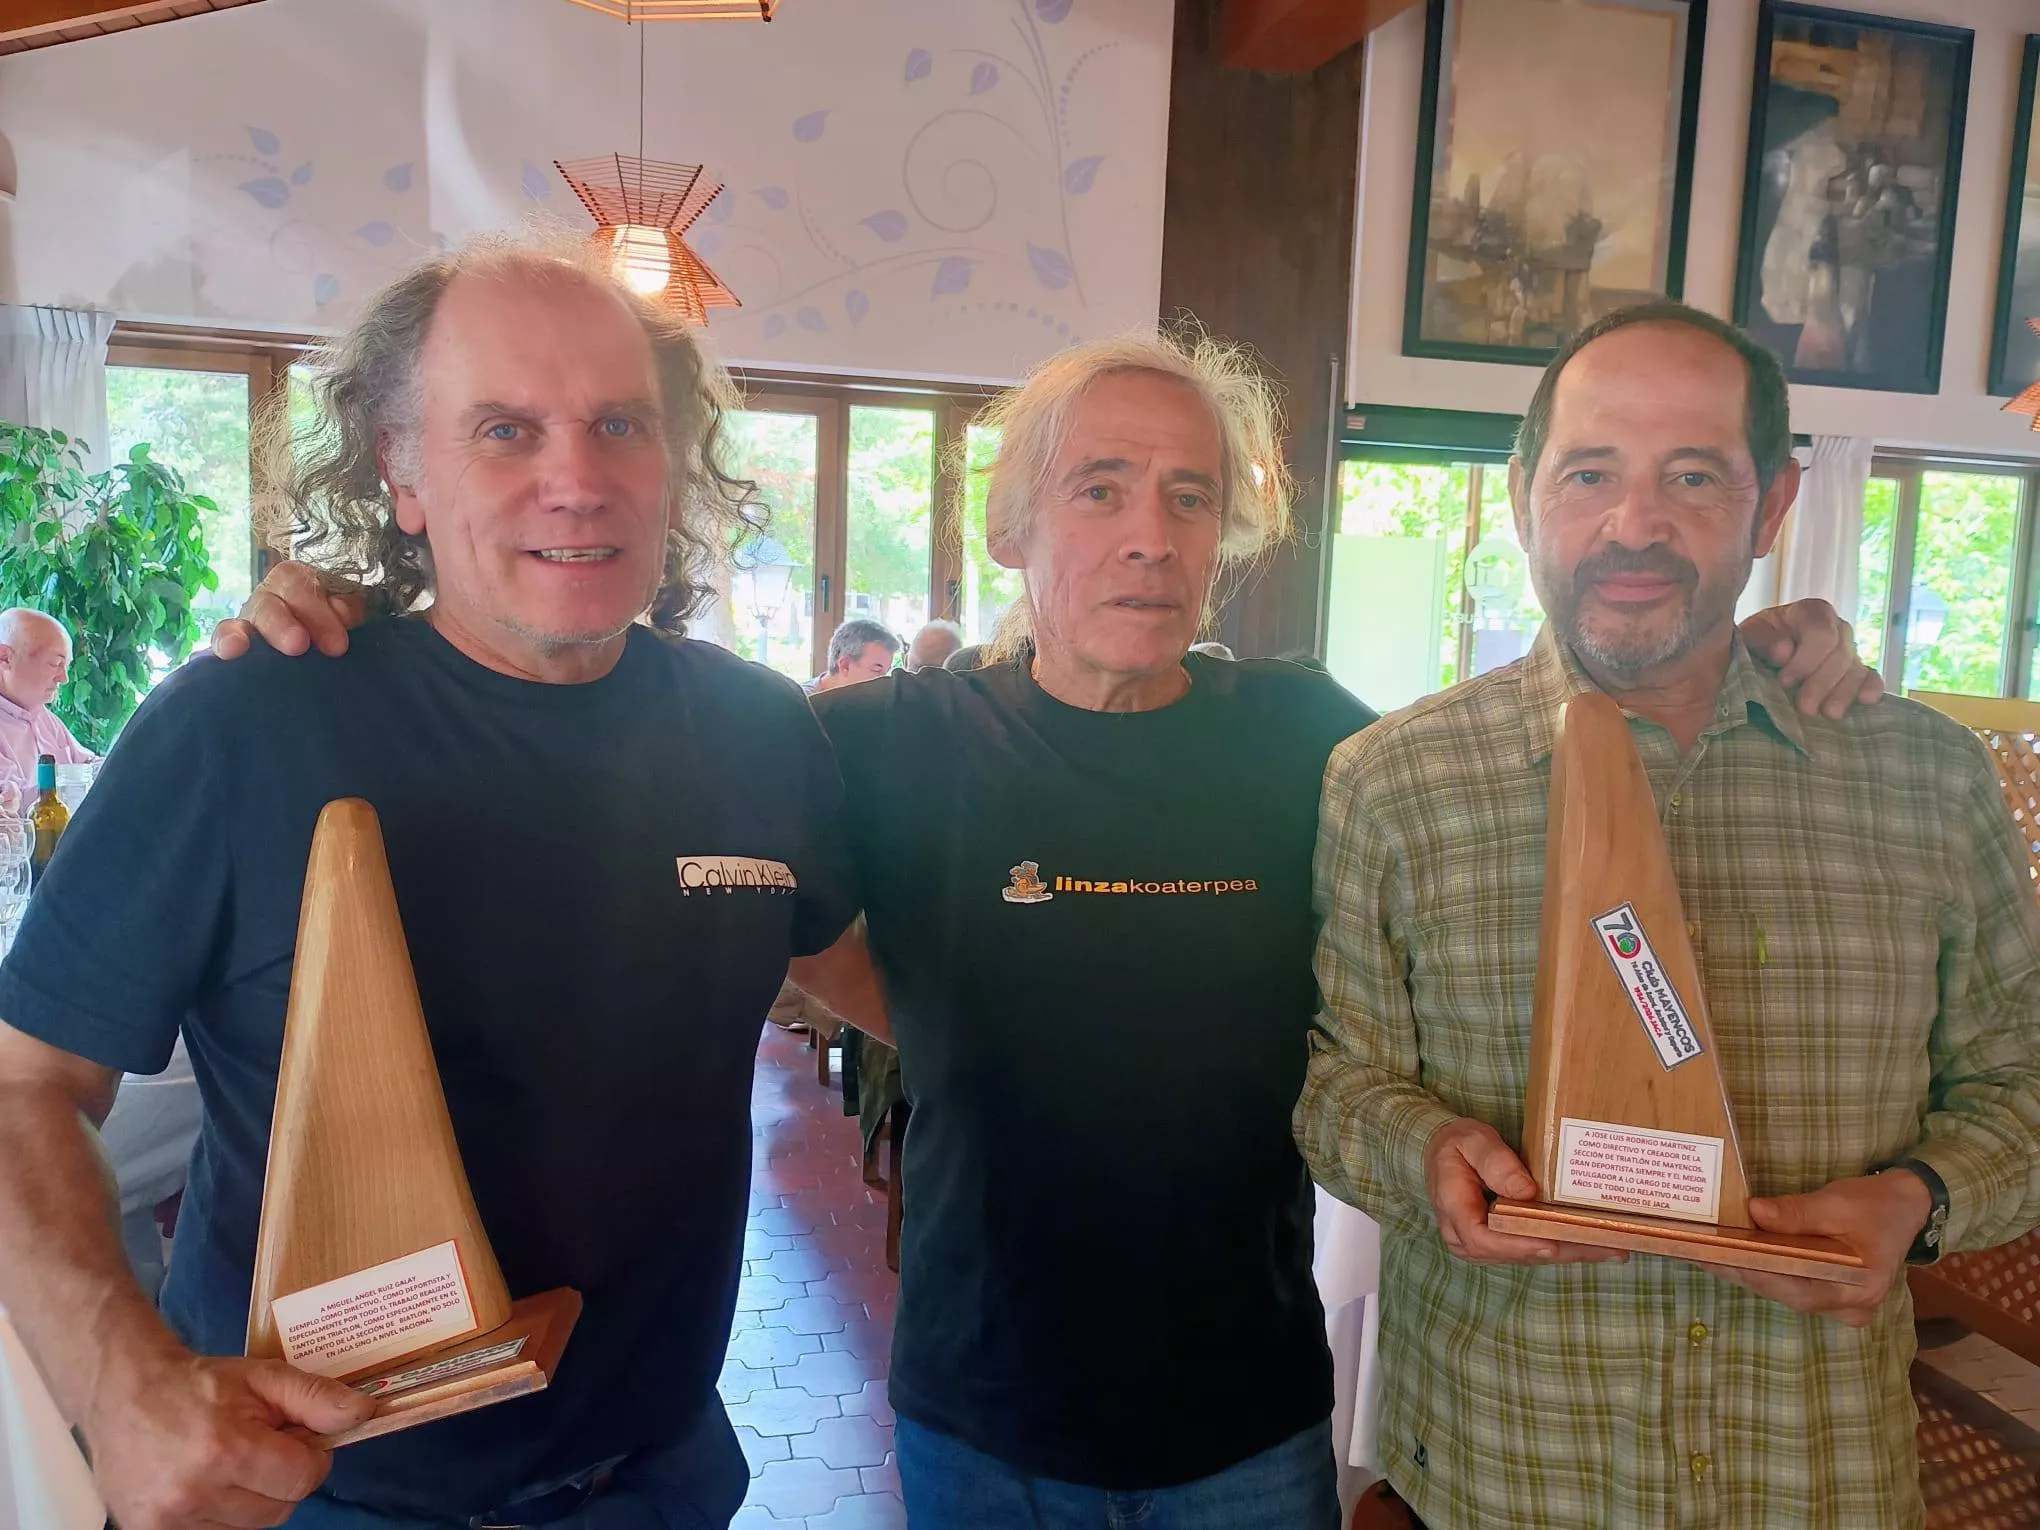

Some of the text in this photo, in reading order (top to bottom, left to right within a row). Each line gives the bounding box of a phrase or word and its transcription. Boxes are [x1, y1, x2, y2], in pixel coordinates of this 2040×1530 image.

[681, 861, 793, 889] Calvin Klein
[1055, 876, 1258, 896] linzakoaterpea
[683, 886, 733, 897] NEW
[1642, 960, 1695, 1053] Club MAYENCOS
[1578, 1140, 1601, 1148] COMO
[1602, 1143, 1639, 1154] DIRECTIVO
[1647, 1149, 1680, 1159] CREADOR
[1610, 1134, 1625, 1142] LUIS
[1626, 1136, 1659, 1147] RODRIGO
[1570, 1159, 1590, 1167] GRAN
[1592, 1162, 1634, 1173] DEPORTISTA
[1635, 1168, 1665, 1178] SIEMPRE
[1683, 1175, 1707, 1184] MEJOR
[1570, 1170, 1617, 1181] DIVULGADOR
[1636, 1179, 1660, 1187] LARGO
[1672, 1184, 1704, 1193] MUCHOS
[1572, 1179, 1592, 1188] AÑOS
[1604, 1184, 1625, 1192] TODO
[1637, 1189, 1671, 1199] RELATIVO
[1683, 1195, 1701, 1203] CLUB
[1601, 1194, 1641, 1205] MAYENCOS
[1653, 1201, 1670, 1209] JACA
[289, 1318, 320, 1333] EJEMPLO
[320, 1310, 343, 1322] COMO
[343, 1297, 382, 1315] DIRECTIVO,
[382, 1289, 404, 1301] COMO
[405, 1275, 446, 1293] DEPORTISTA
[326, 1297, 354, 1311] MIGUEL
[354, 1289, 378, 1302] ANGEL
[378, 1284, 394, 1294] RUIZ
[394, 1276, 417, 1288] GALAY
[288, 1281, 456, 1343] ESPECIALMENTE POR TODO EL TRABAJO REALIZADO
[291, 1338, 316, 1351] TANTO
[316, 1335, 326, 1343] EN
[363, 1314, 386, 1327] COMO
[386, 1296, 440, 1319] ESPECIALMENTE
[293, 1348, 314, 1360] GRAN
[346, 1334, 355, 1342] LA
[385, 1321, 395, 1329] DE
[431, 1304, 442, 1313] NO
[326, 1350, 336, 1359] EN
[336, 1344, 355, 1356] JACA
[354, 1338, 372, 1349] SINO
[379, 1329, 399, 1340] NIVEL
[399, 1317, 434, 1333] NACIONAL
